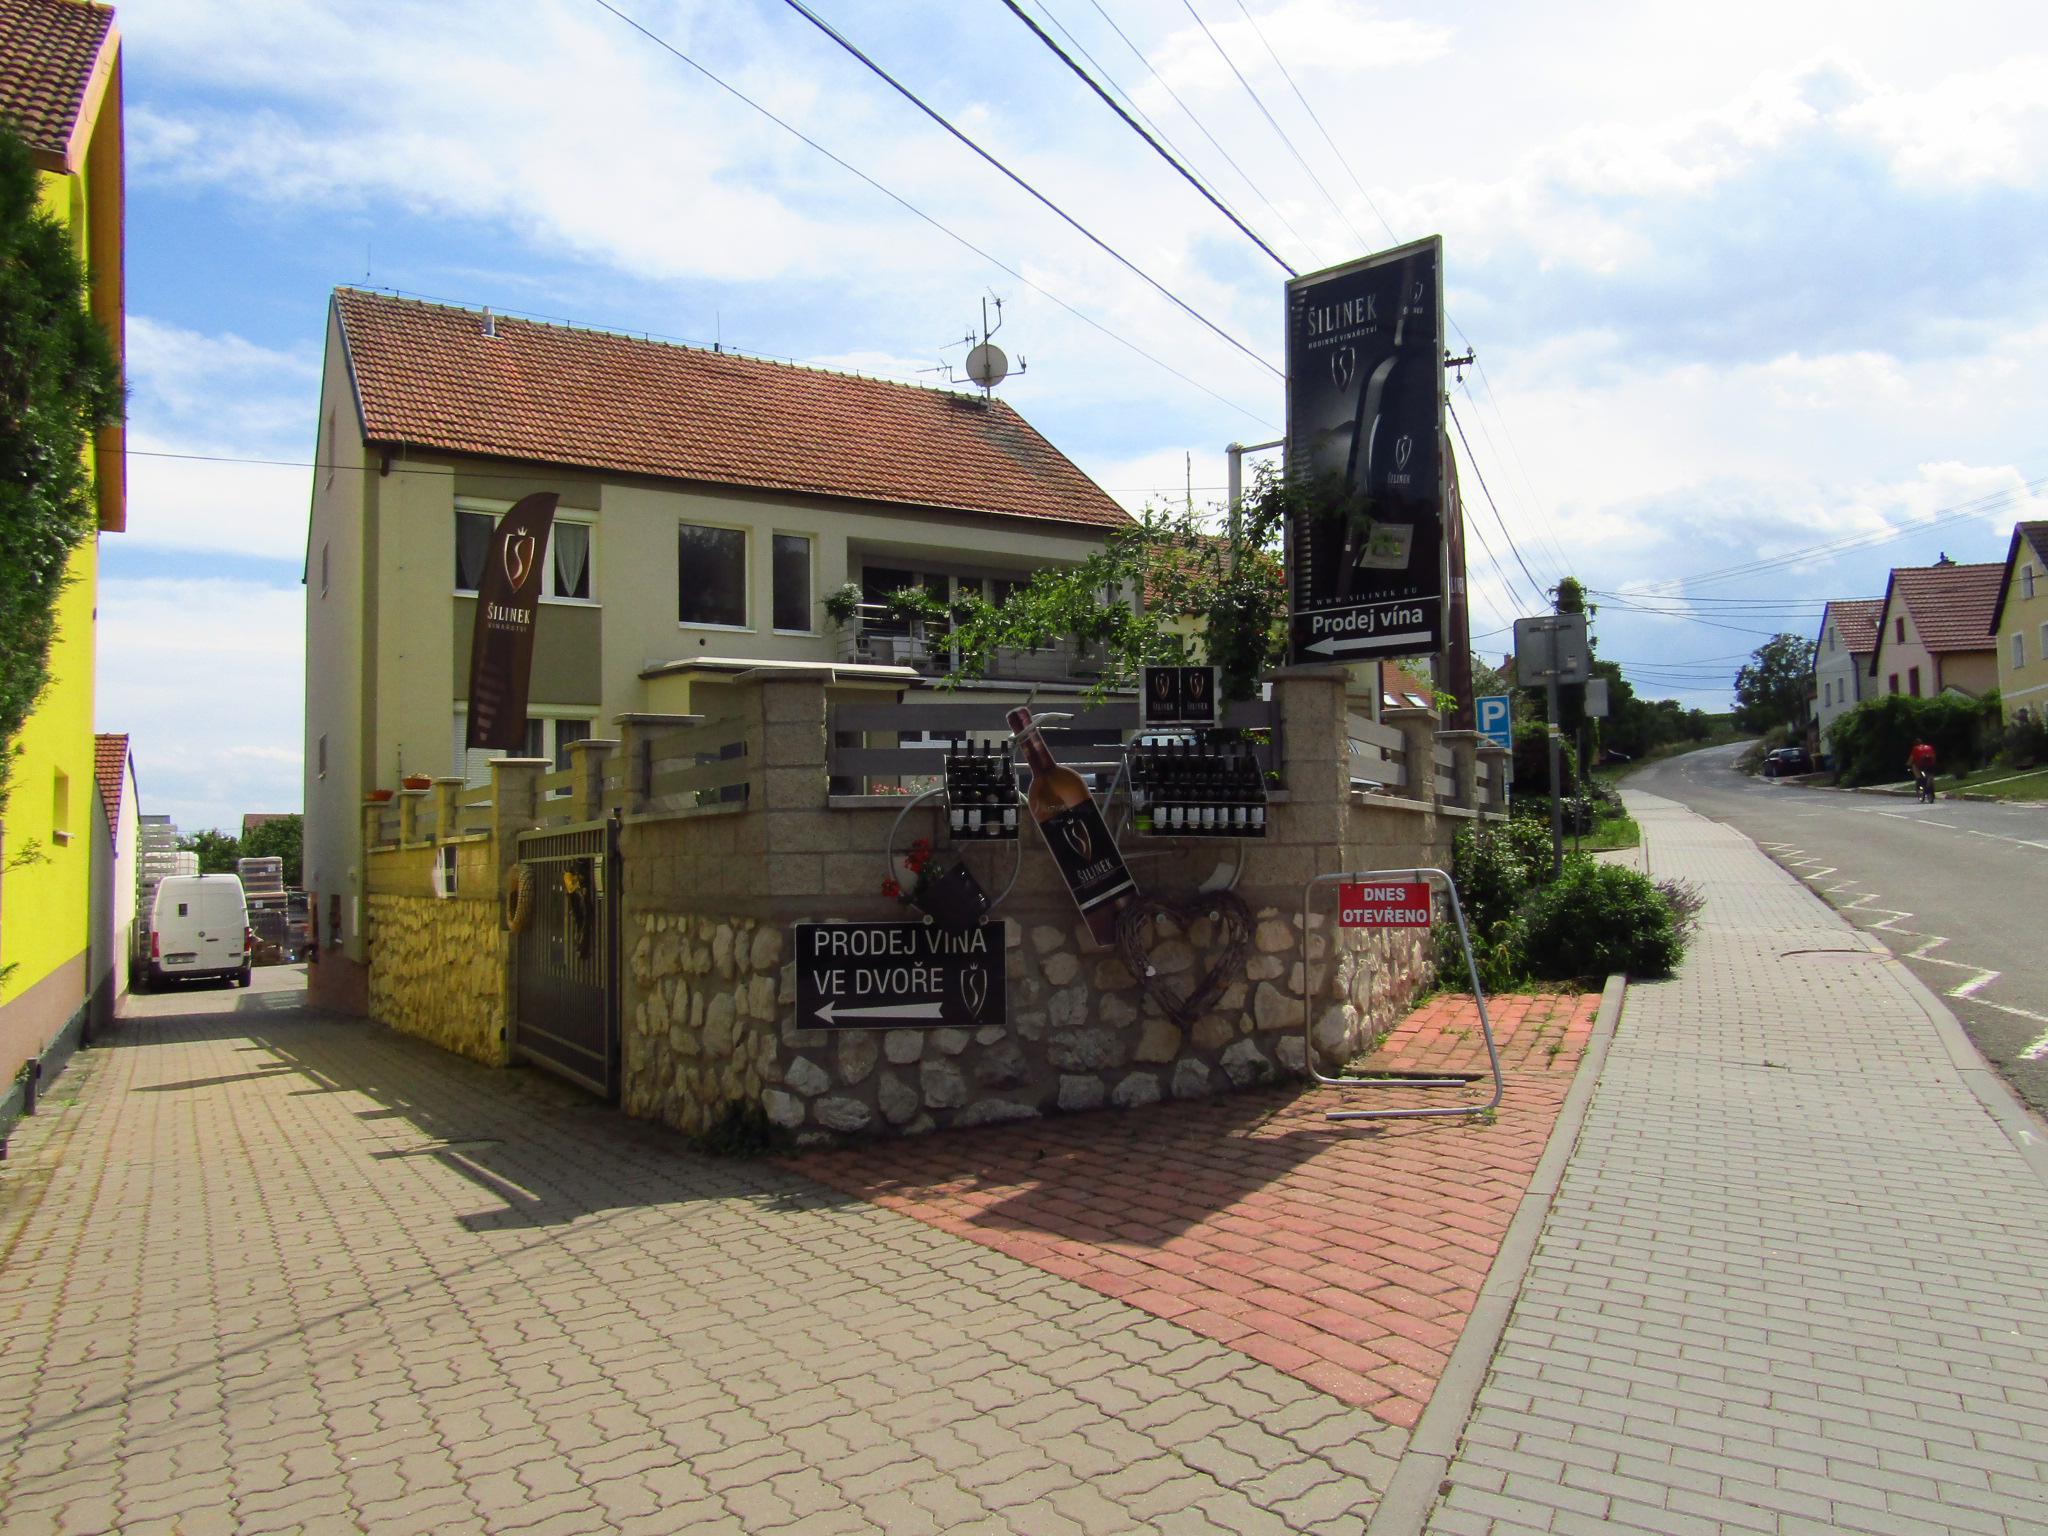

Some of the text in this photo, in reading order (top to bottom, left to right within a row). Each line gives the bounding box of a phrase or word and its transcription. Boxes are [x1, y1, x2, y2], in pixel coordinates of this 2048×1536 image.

[1308, 294, 1377, 336] ŠILINEK
[487, 602, 531, 625] ŠILINEK
[1312, 605, 1423, 634] Prodej vína
[1482, 701, 1506, 731] P
[1363, 888, 1406, 902] DNES
[1342, 906, 1428, 923] OTEVŘENO
[814, 929, 916, 956] PRODEJ
[813, 961, 944, 995] VE DVOŘE
